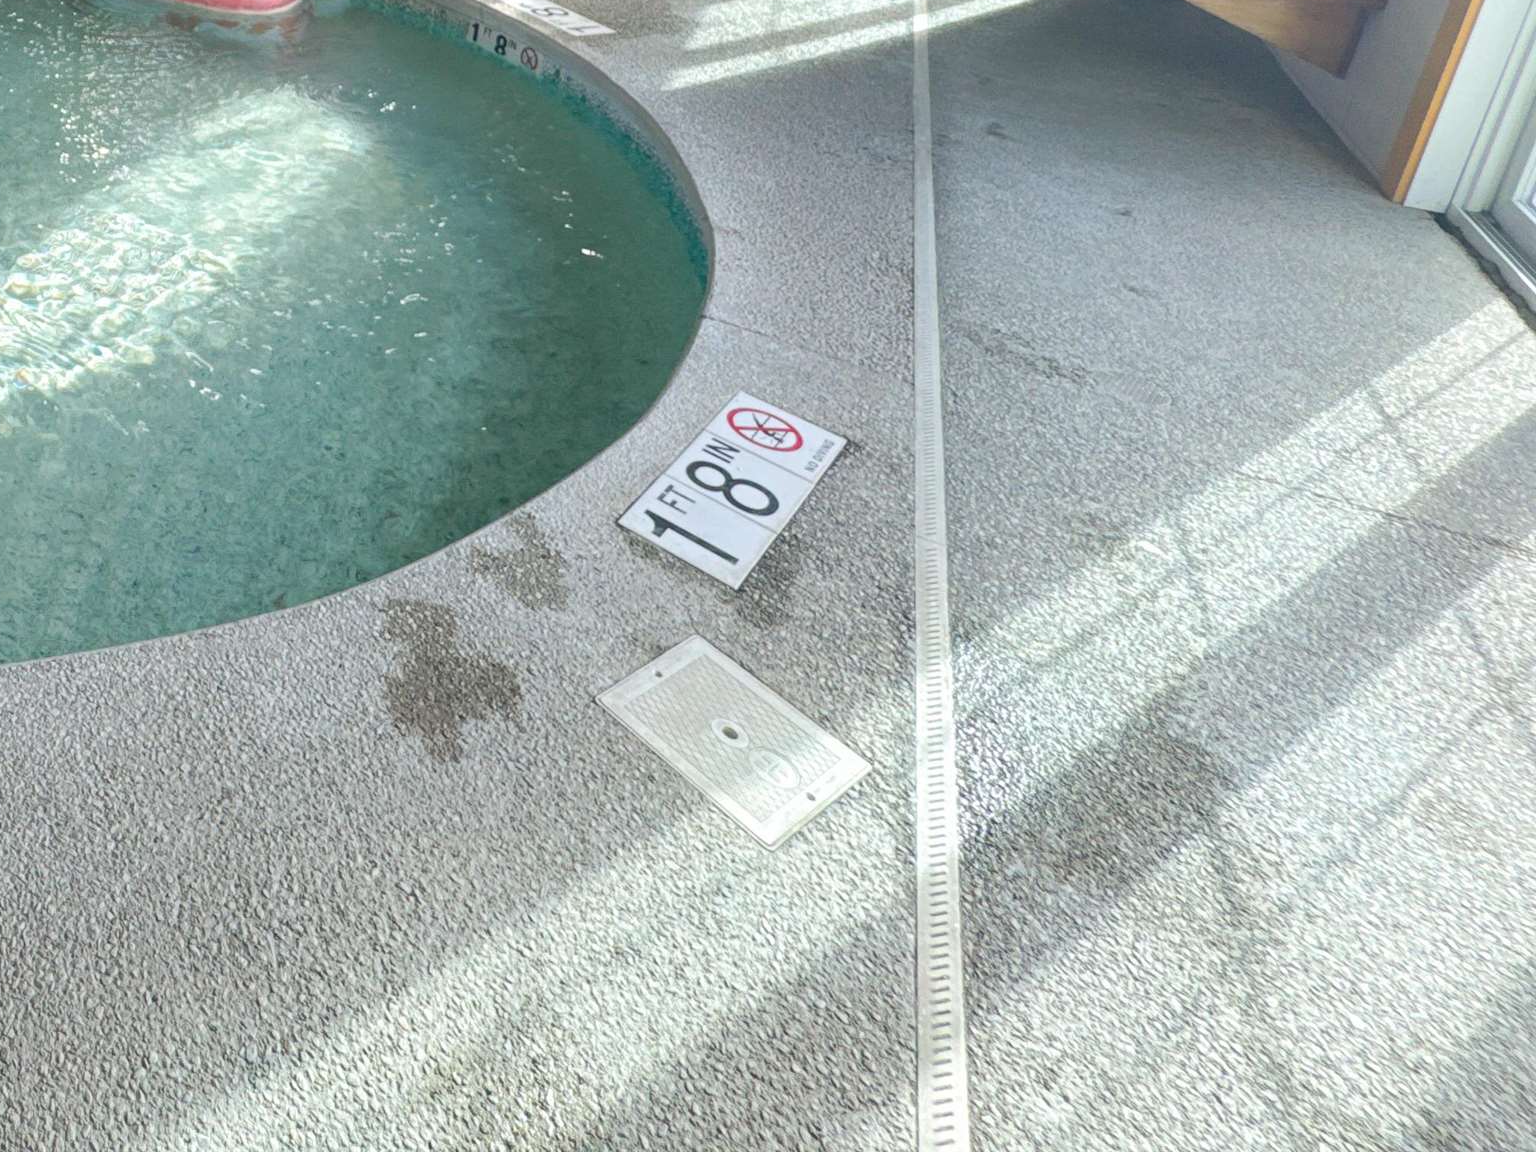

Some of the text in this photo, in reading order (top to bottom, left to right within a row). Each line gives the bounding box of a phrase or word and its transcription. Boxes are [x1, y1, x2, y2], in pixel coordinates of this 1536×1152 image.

[472, 23, 480, 42] 1
[494, 35, 507, 55] 8
[644, 437, 780, 565] 1 FT 8 IN
